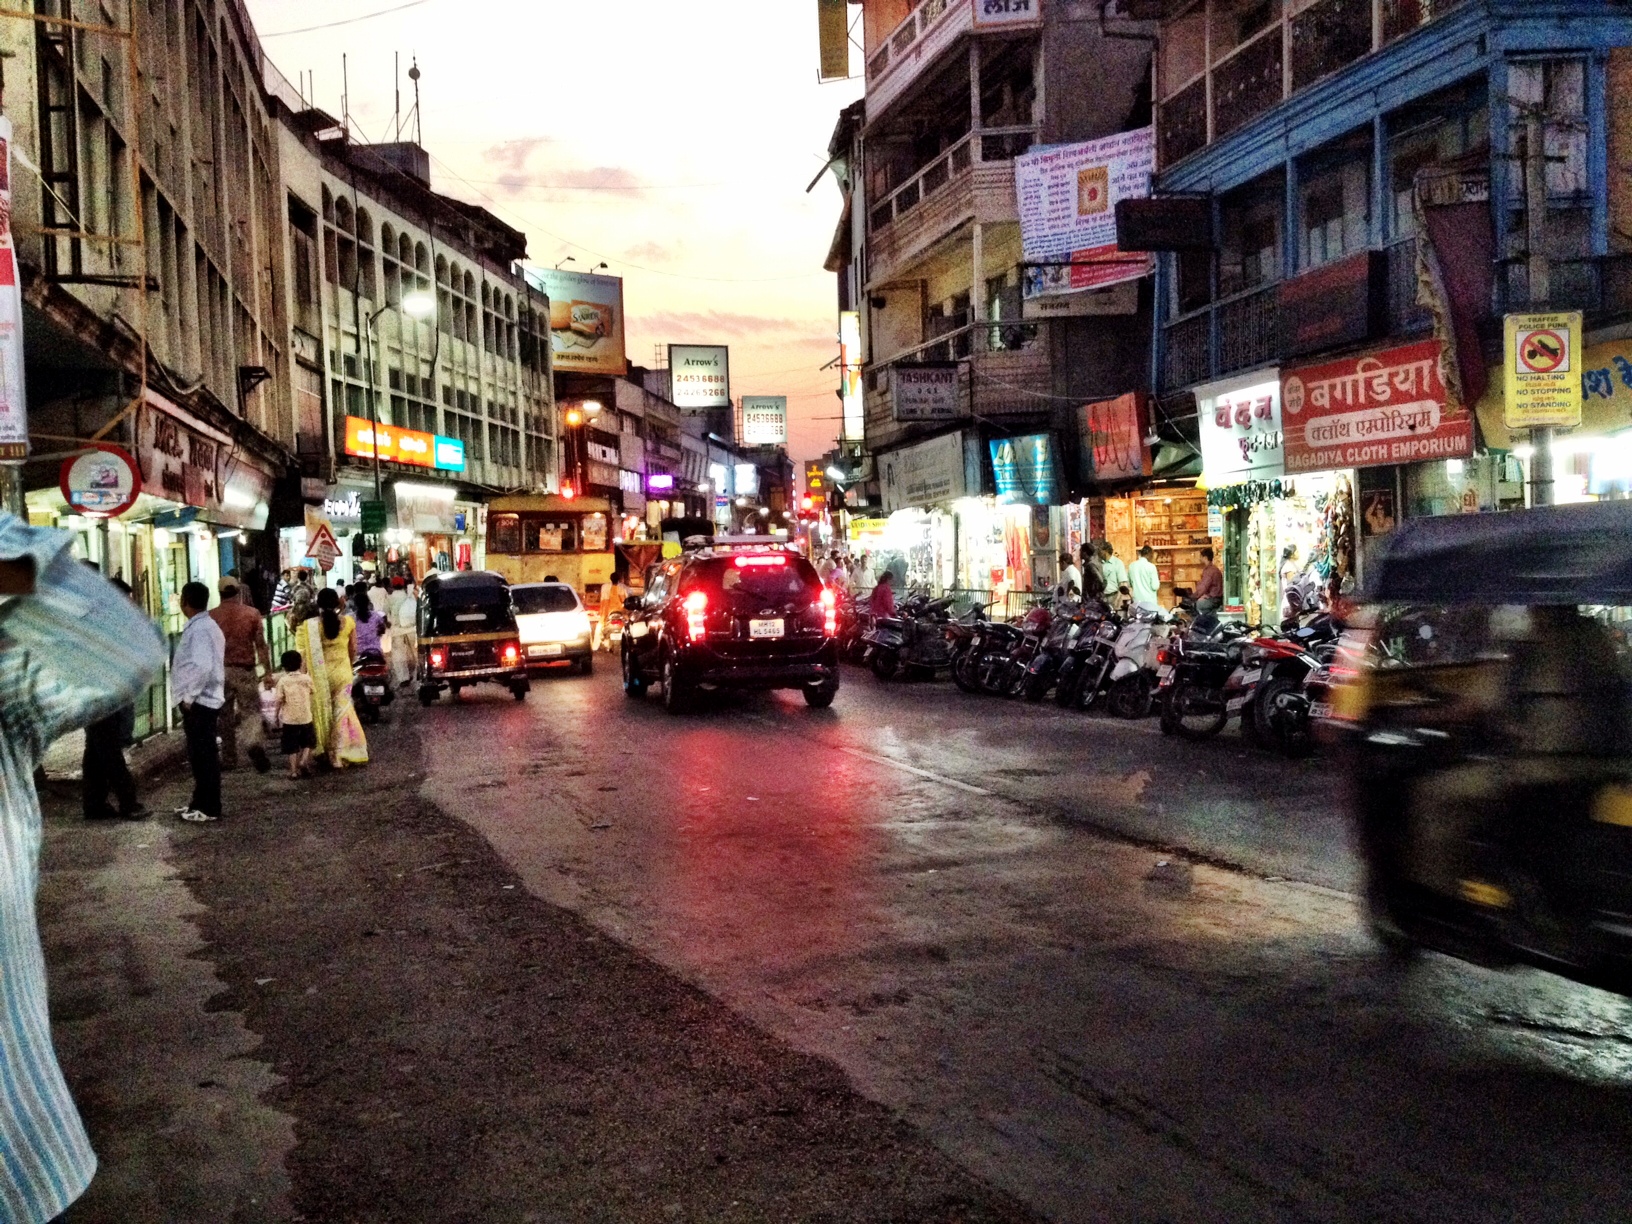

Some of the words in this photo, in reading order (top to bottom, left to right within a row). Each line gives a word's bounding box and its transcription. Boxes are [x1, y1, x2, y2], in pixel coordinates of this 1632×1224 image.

[684, 355, 719, 366] Arrow's
[676, 375, 725, 383] 24536688
[901, 373, 954, 384] TASHKANT
[1307, 357, 1433, 409] बगडिया
[1215, 394, 1273, 430] वंदन
[1530, 401, 1572, 409] STANDING
[1311, 418, 1350, 441] क्लॉथ
[1287, 449, 1343, 468] BAGADIYA
[1347, 443, 1388, 461] CLOTH
[1392, 435, 1467, 455] EMPORIUM
